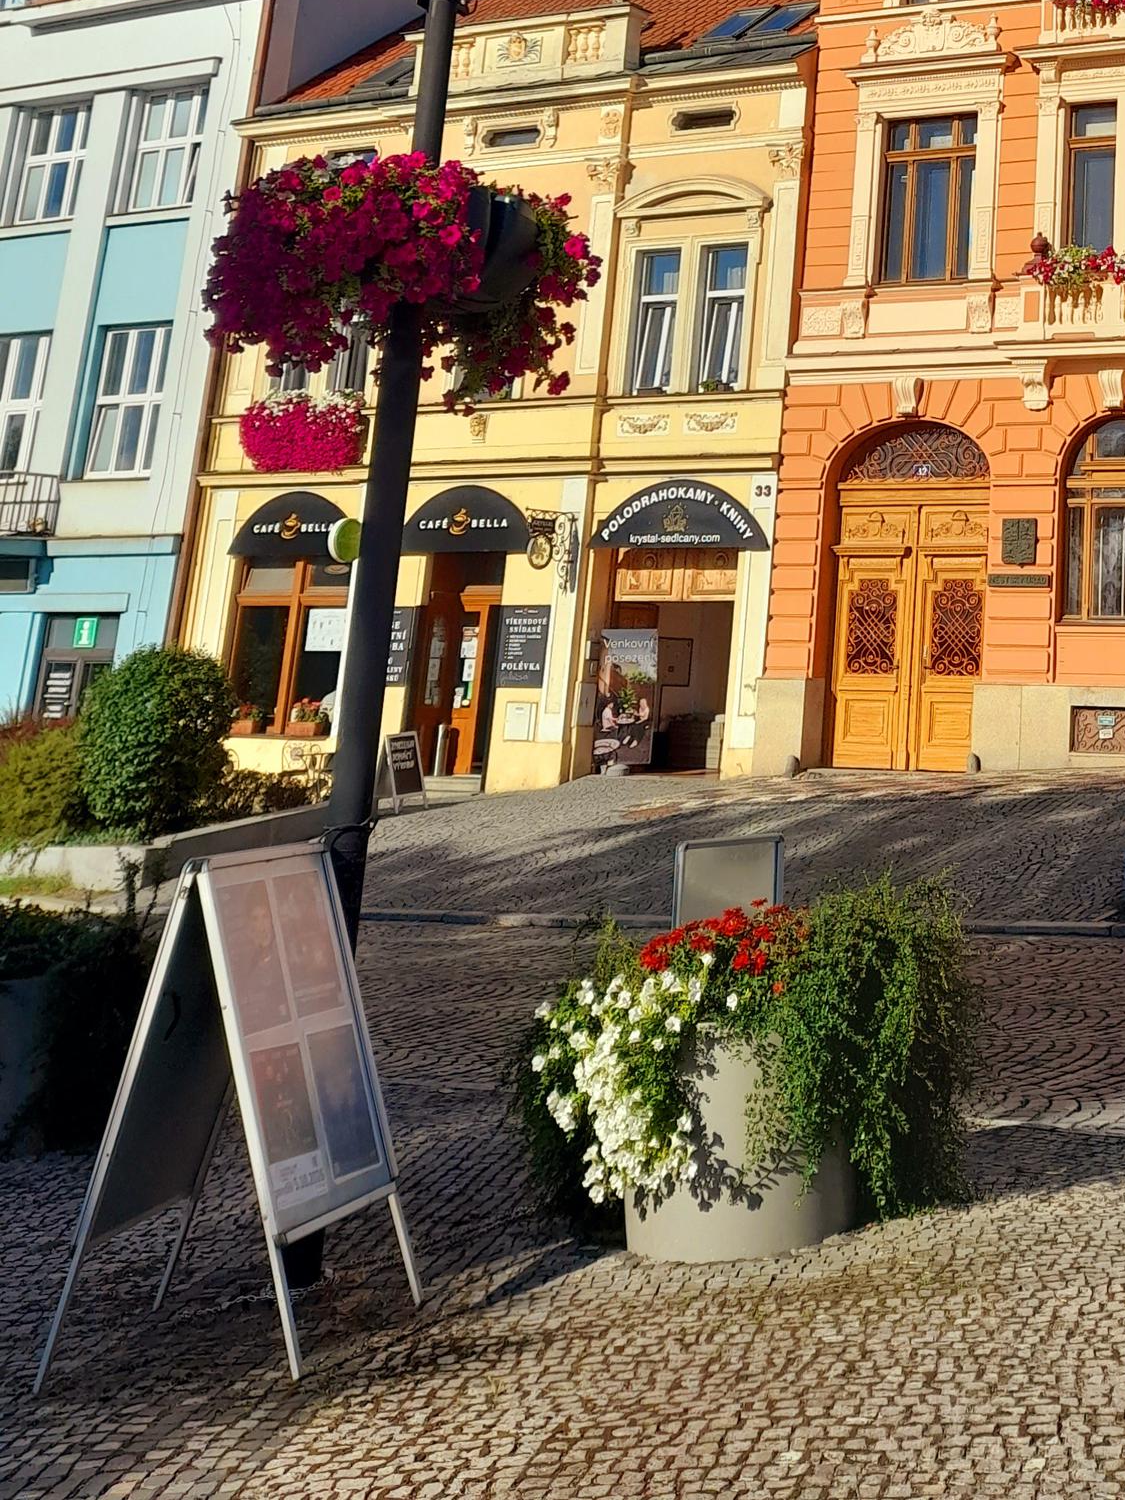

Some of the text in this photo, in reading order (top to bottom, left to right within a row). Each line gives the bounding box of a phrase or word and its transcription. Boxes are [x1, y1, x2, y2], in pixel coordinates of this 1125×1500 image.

[755, 485, 772, 497] 33
[601, 487, 754, 541] POLODRAHOKAMY KNIHY
[252, 522, 281, 534] CAFÉ
[418, 517, 508, 530] CAFÉ BELLA
[505, 617, 548, 626] VÍKENDOVÉ
[501, 661, 540, 671] POLÉVKA
